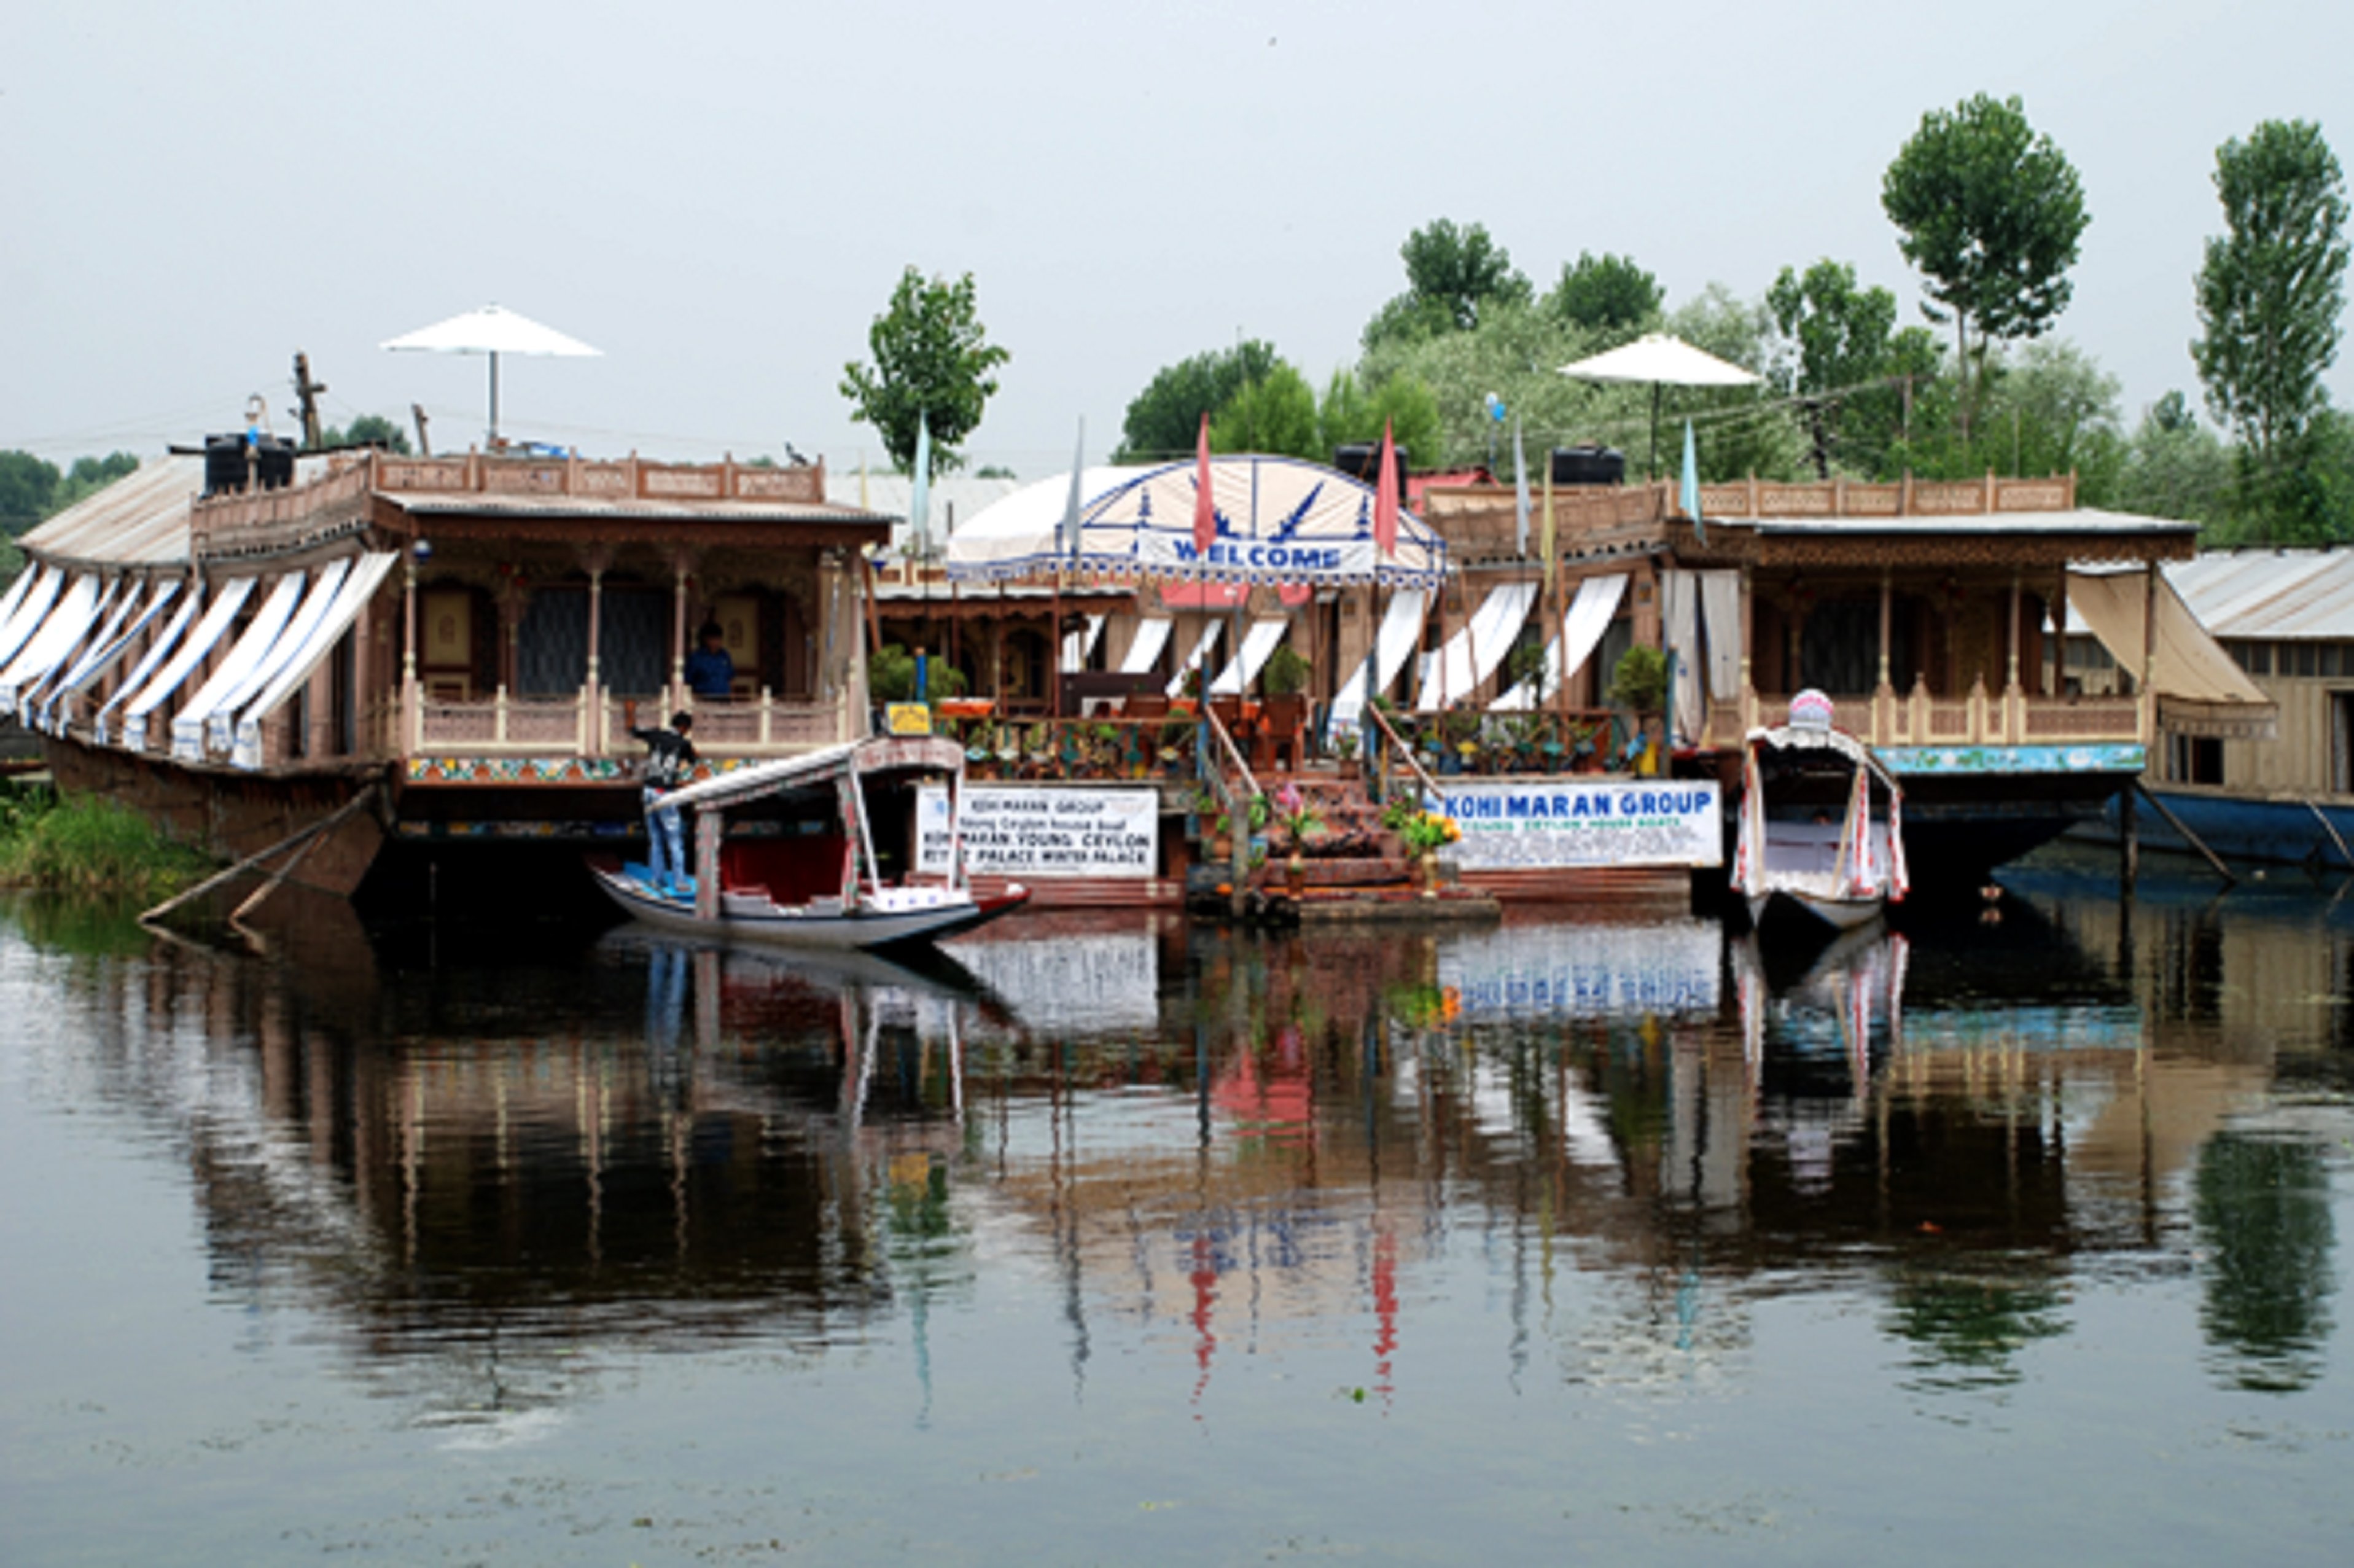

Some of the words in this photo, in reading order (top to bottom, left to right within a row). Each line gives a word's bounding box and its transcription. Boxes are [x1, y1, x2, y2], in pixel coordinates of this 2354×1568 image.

[1173, 539, 1341, 569] WELCOME
[1055, 800, 1104, 814] GROUP
[1506, 794, 1612, 817] MARAN
[1619, 791, 1712, 816] GROUP
[1016, 833, 1073, 847] YOUNG
[1082, 833, 1150, 848] CEYLON
[976, 849, 1032, 862] PALACE
